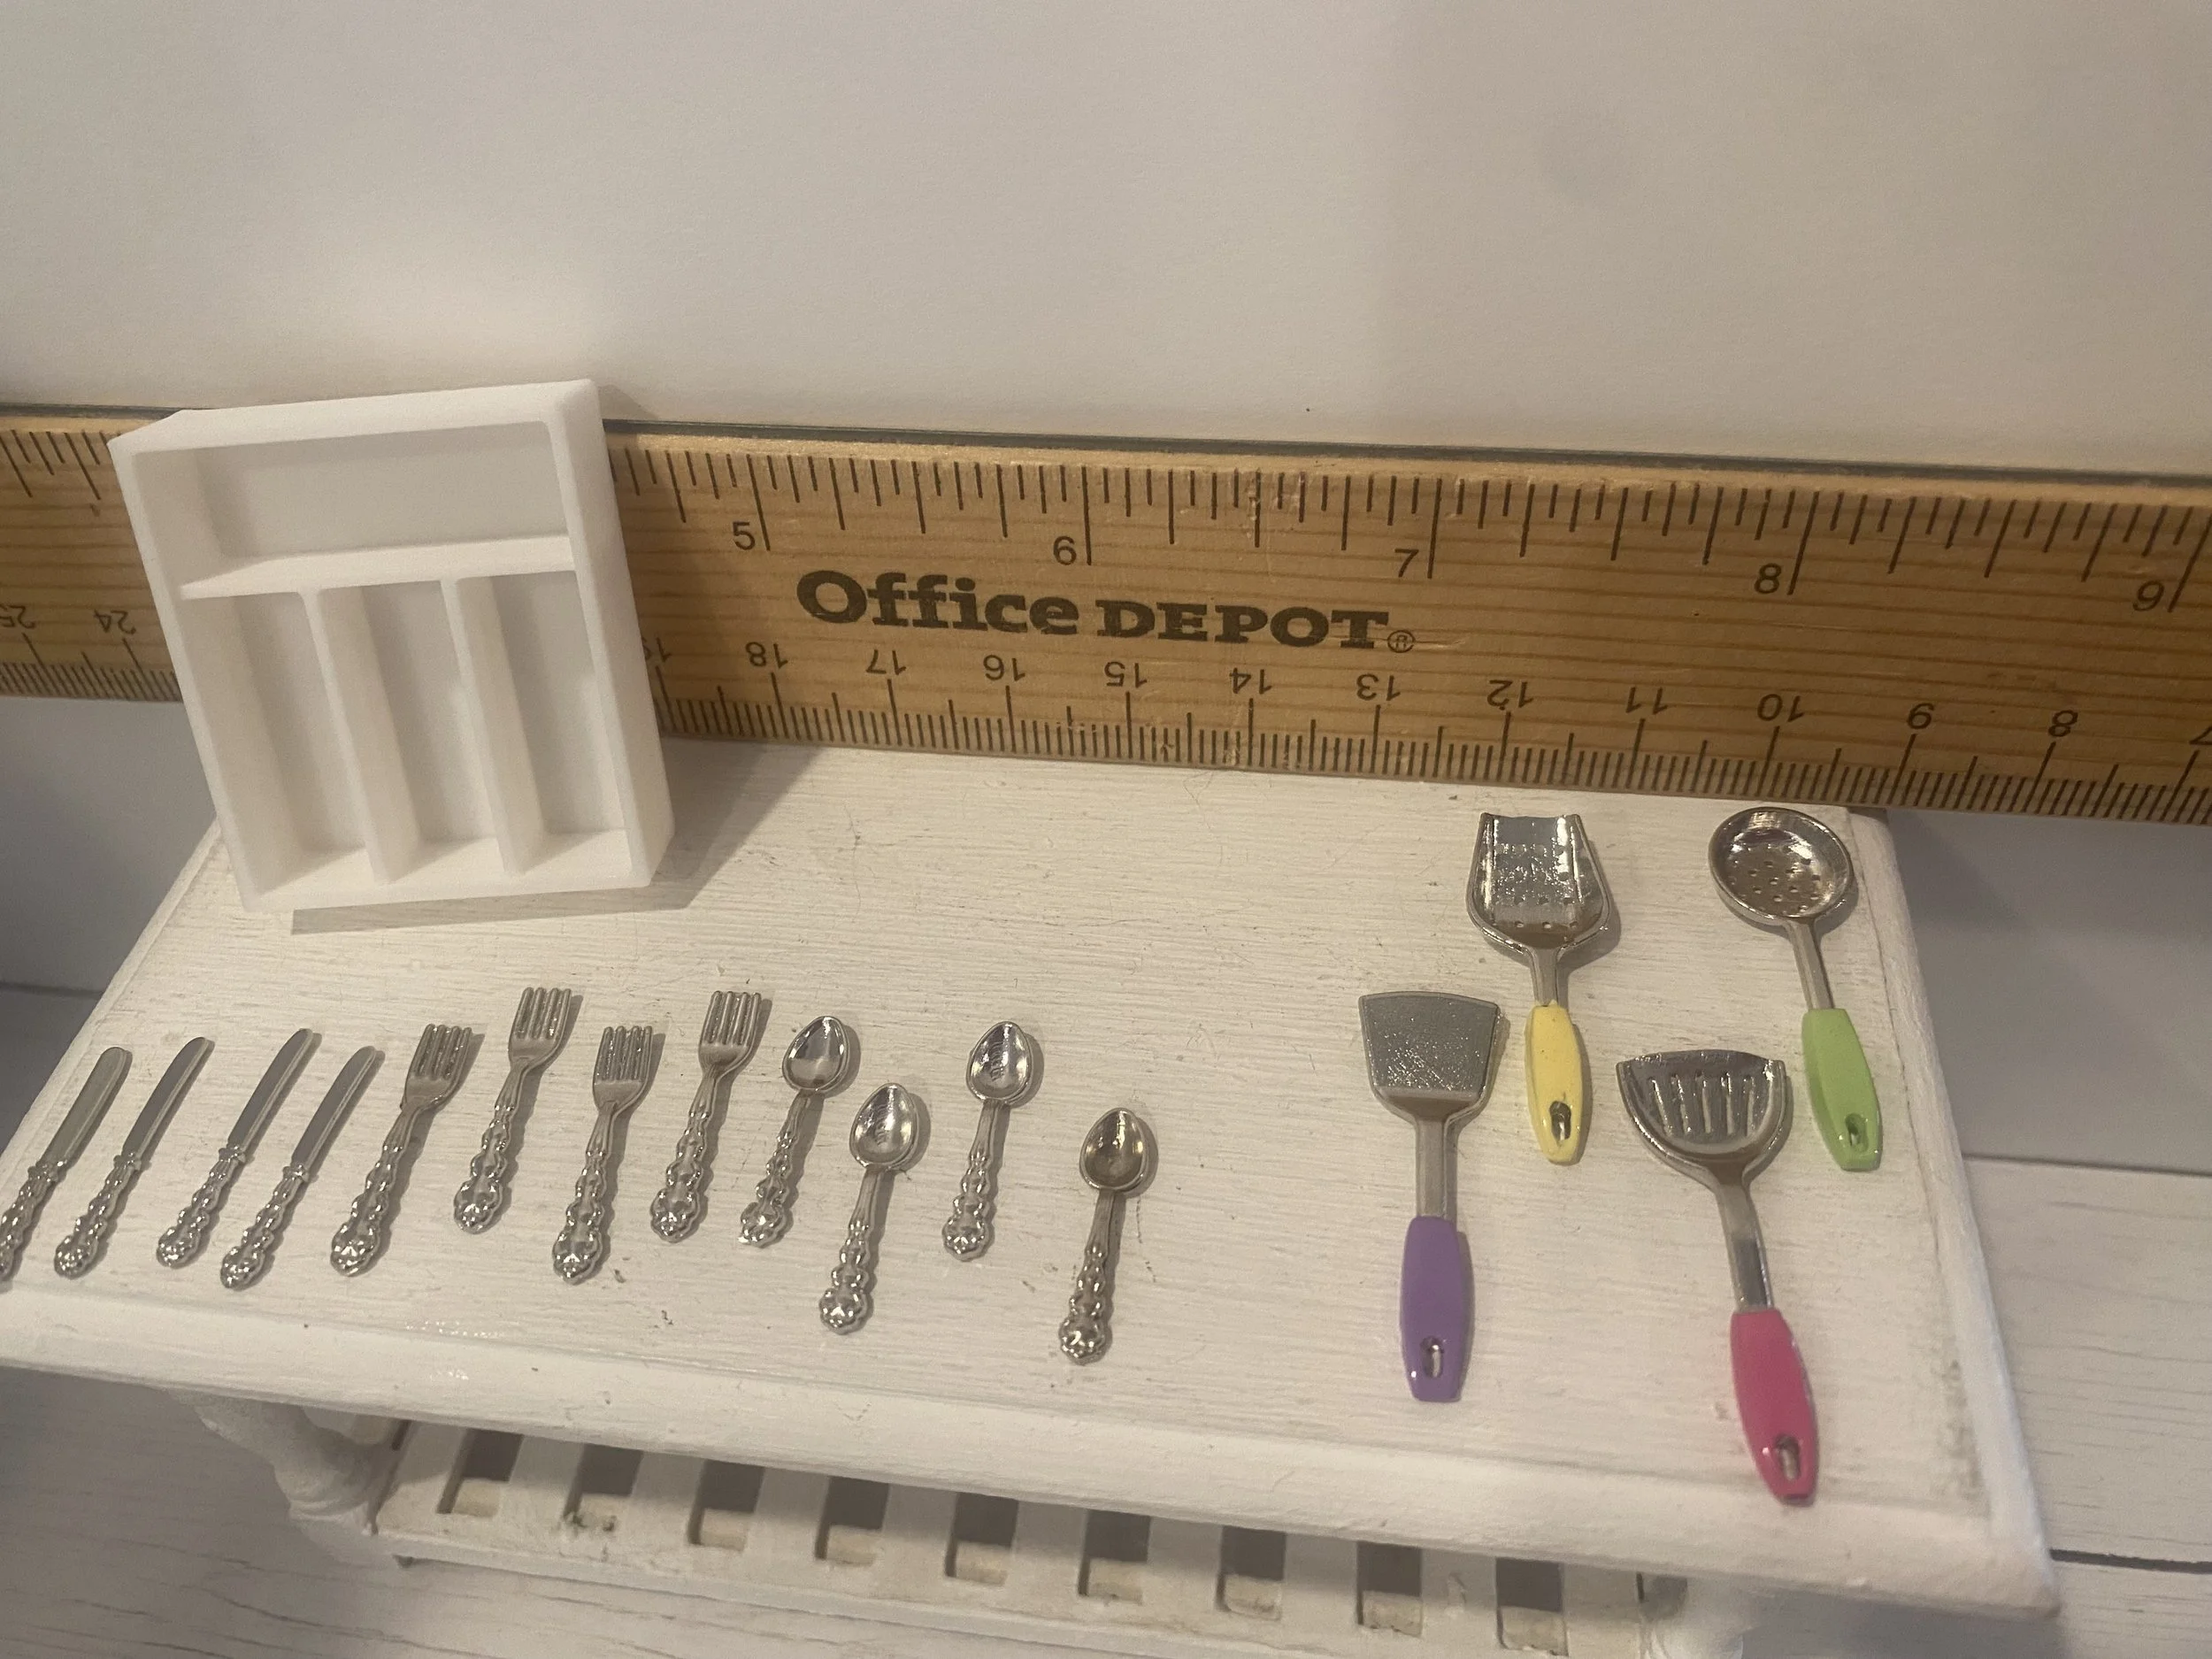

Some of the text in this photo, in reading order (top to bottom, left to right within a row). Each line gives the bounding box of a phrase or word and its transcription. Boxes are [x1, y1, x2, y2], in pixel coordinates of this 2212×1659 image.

[732, 521, 756, 551] 5
[1053, 535, 1078, 565] 6
[1394, 548, 1419, 578] 7
[1755, 562, 1781, 595] 8
[797, 569, 1079, 636] Office
[2131, 580, 2165, 612] 9
[94, 609, 136, 634] 24
[745, 641, 789, 671] 18
[865, 649, 907, 676] 17
[983, 654, 1026, 682] 16
[1104, 661, 1148, 688] 15
[1229, 667, 1272, 695] 14
[1356, 673, 1402, 702] 13
[1487, 679, 1535, 707] 12
[1624, 686, 1669, 715] 11
[1756, 693, 1804, 722] 10
[1906, 702, 1936, 731] 9
[2047, 710, 2078, 738] 8
